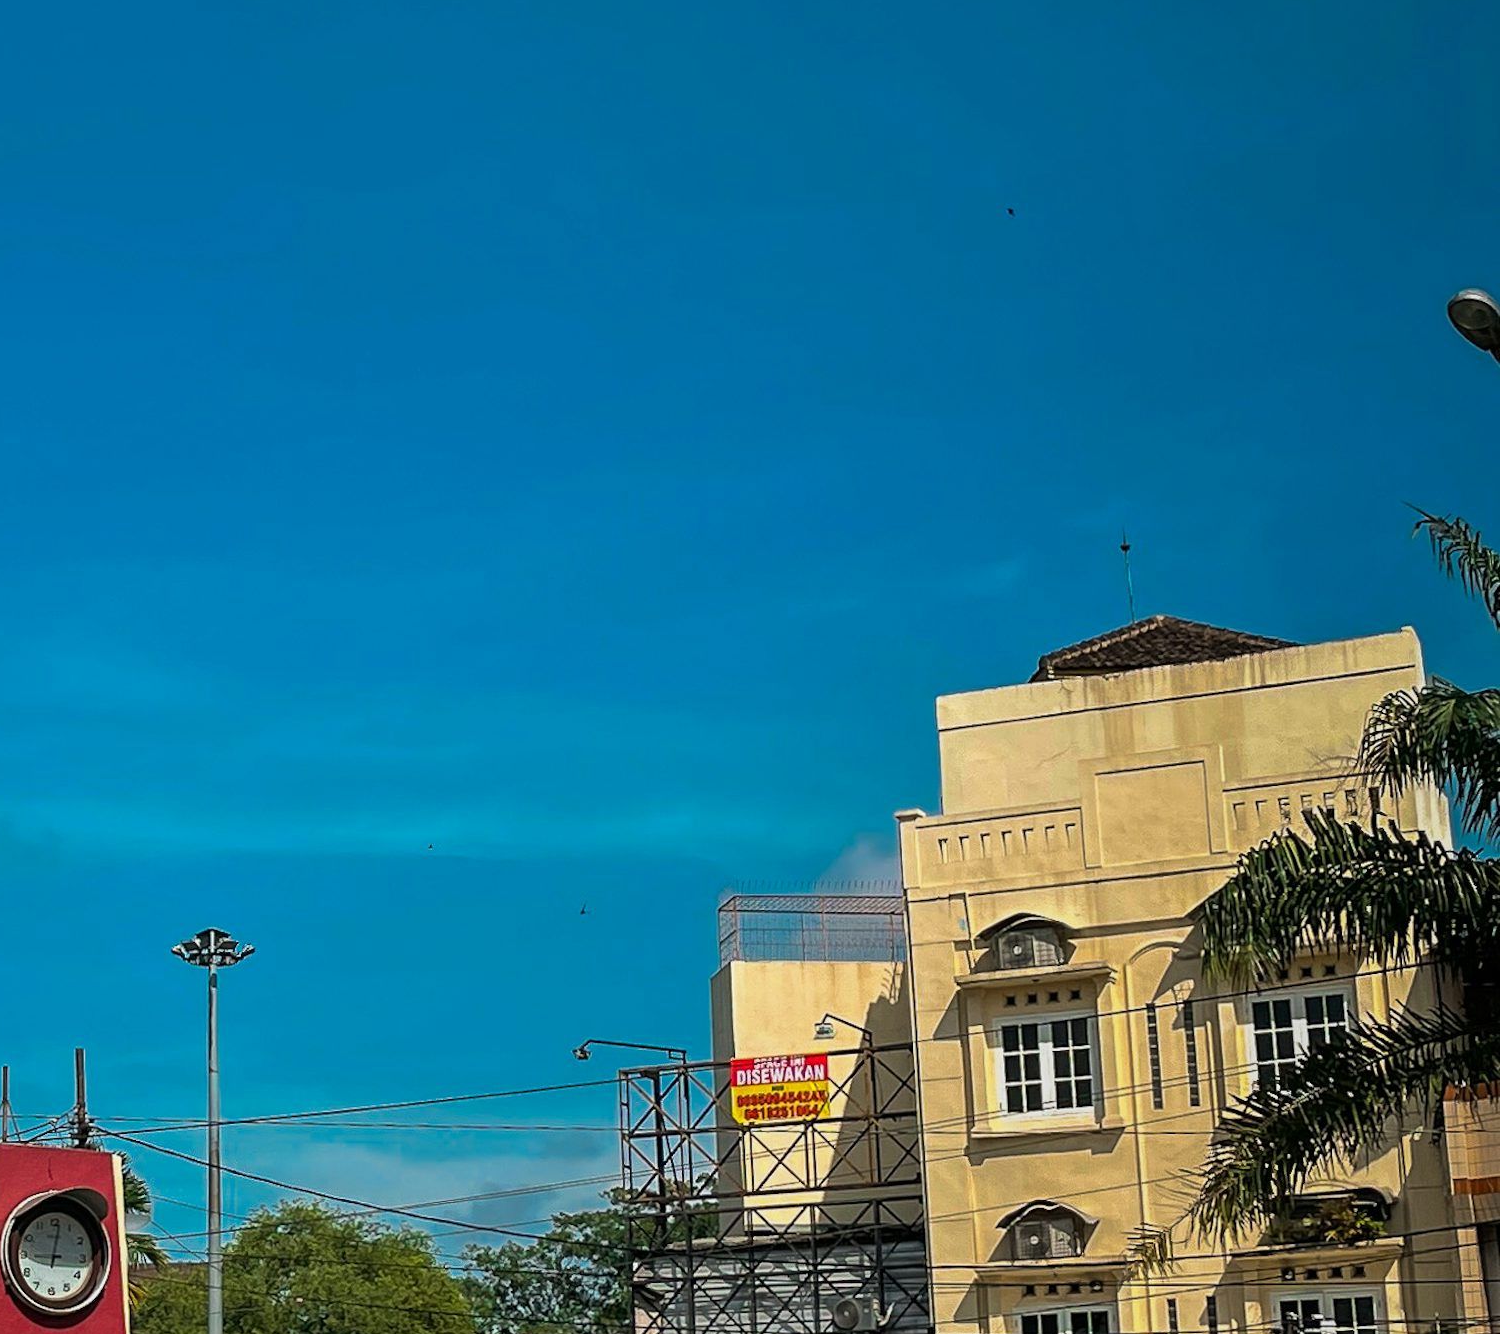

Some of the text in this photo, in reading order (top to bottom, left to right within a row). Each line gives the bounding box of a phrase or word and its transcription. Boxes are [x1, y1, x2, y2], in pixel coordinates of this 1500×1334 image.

[736, 1063, 825, 1086] DISEWAKAN
[23, 1267, 31, 1278] 8
[73, 1270, 81, 1280] 4
[33, 1281, 40, 1290] 7
[63, 1283, 71, 1292] 5
[47, 1287, 56, 1296] 6
